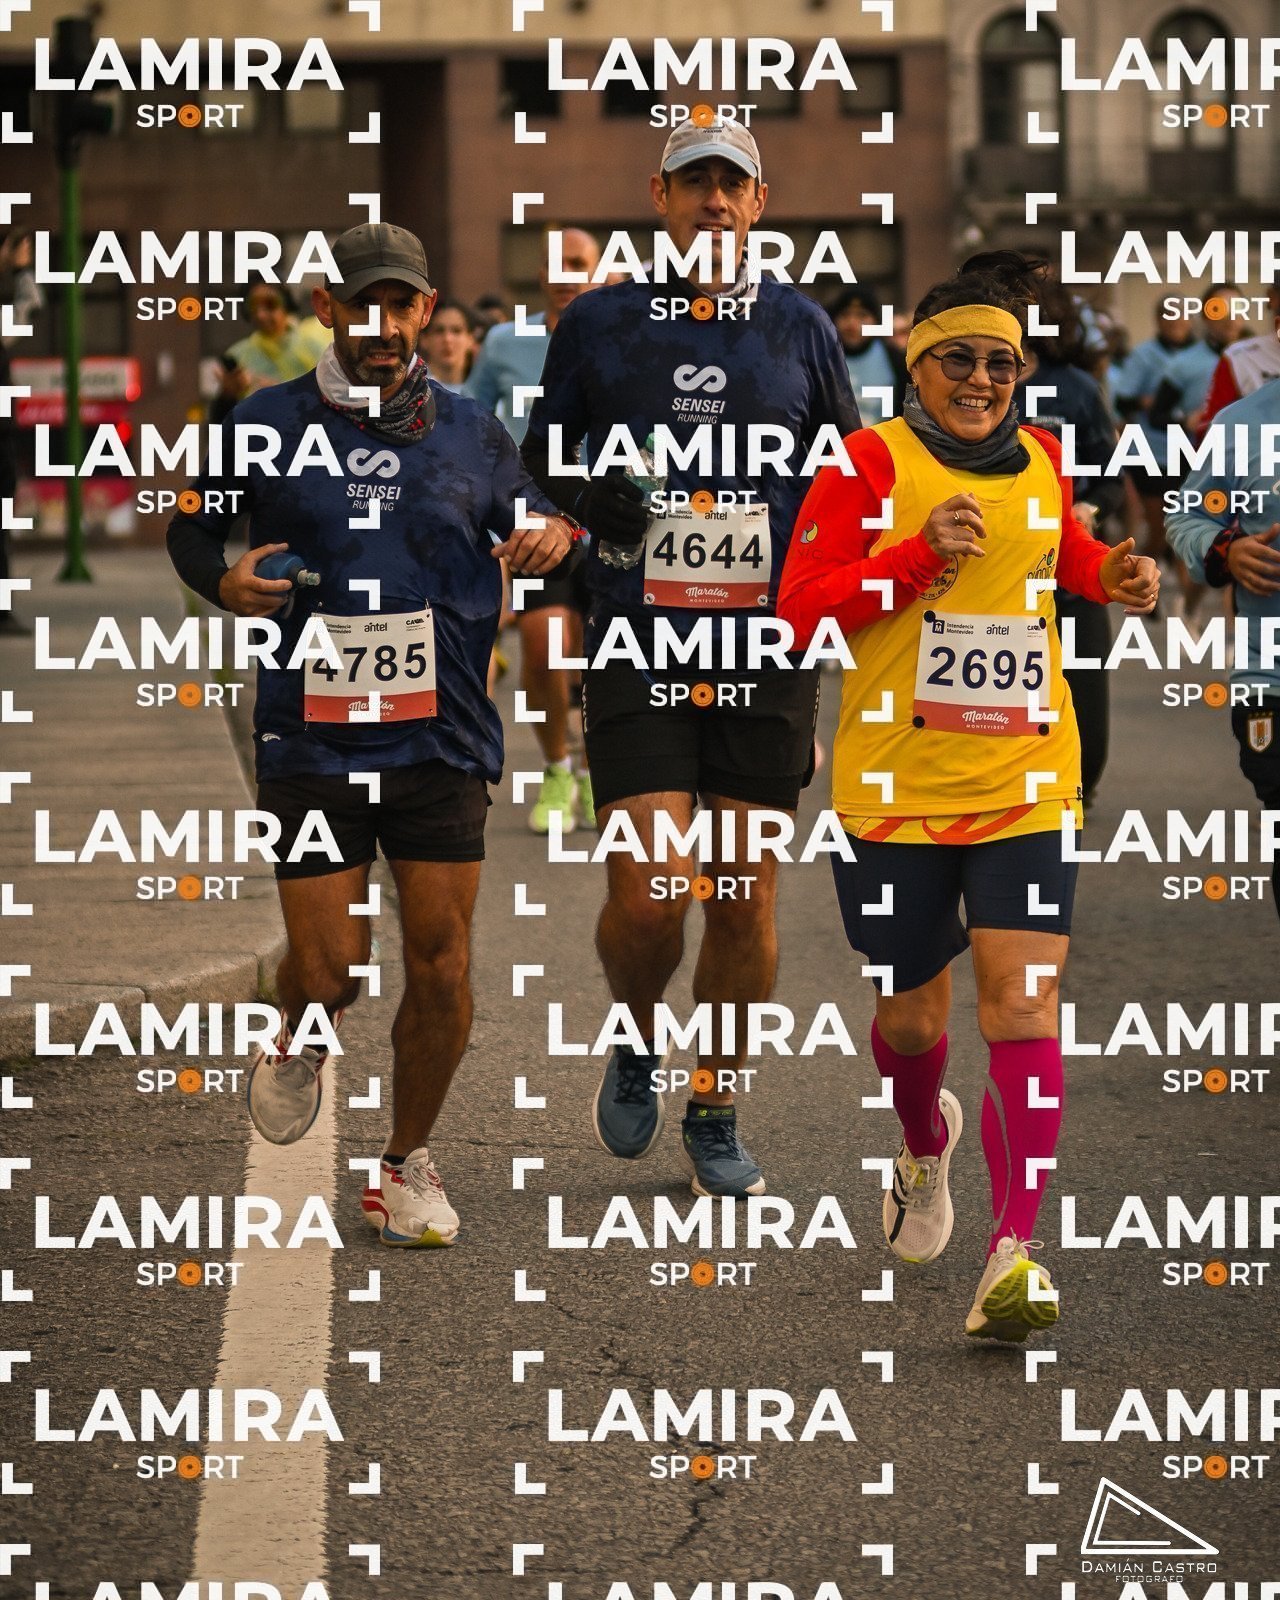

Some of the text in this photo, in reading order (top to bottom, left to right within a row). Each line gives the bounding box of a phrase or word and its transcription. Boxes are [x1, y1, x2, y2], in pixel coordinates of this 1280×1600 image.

[671, 397, 726, 414] SENSEI
[677, 413, 718, 424] RUNNING
[346, 483, 402, 500] SENSEI
[352, 500, 395, 512] RUNNG
[704, 510, 728, 521] antel
[652, 531, 764, 570] 4644
[685, 586, 730, 599] Maratón
[364, 622, 388, 633] antel
[946, 622, 974, 630] Intendencia
[986, 624, 1010, 636] antel
[312, 642, 427, 683] 4785
[926, 646, 1044, 691] 2695
[961, 709, 1010, 725] Maratón
